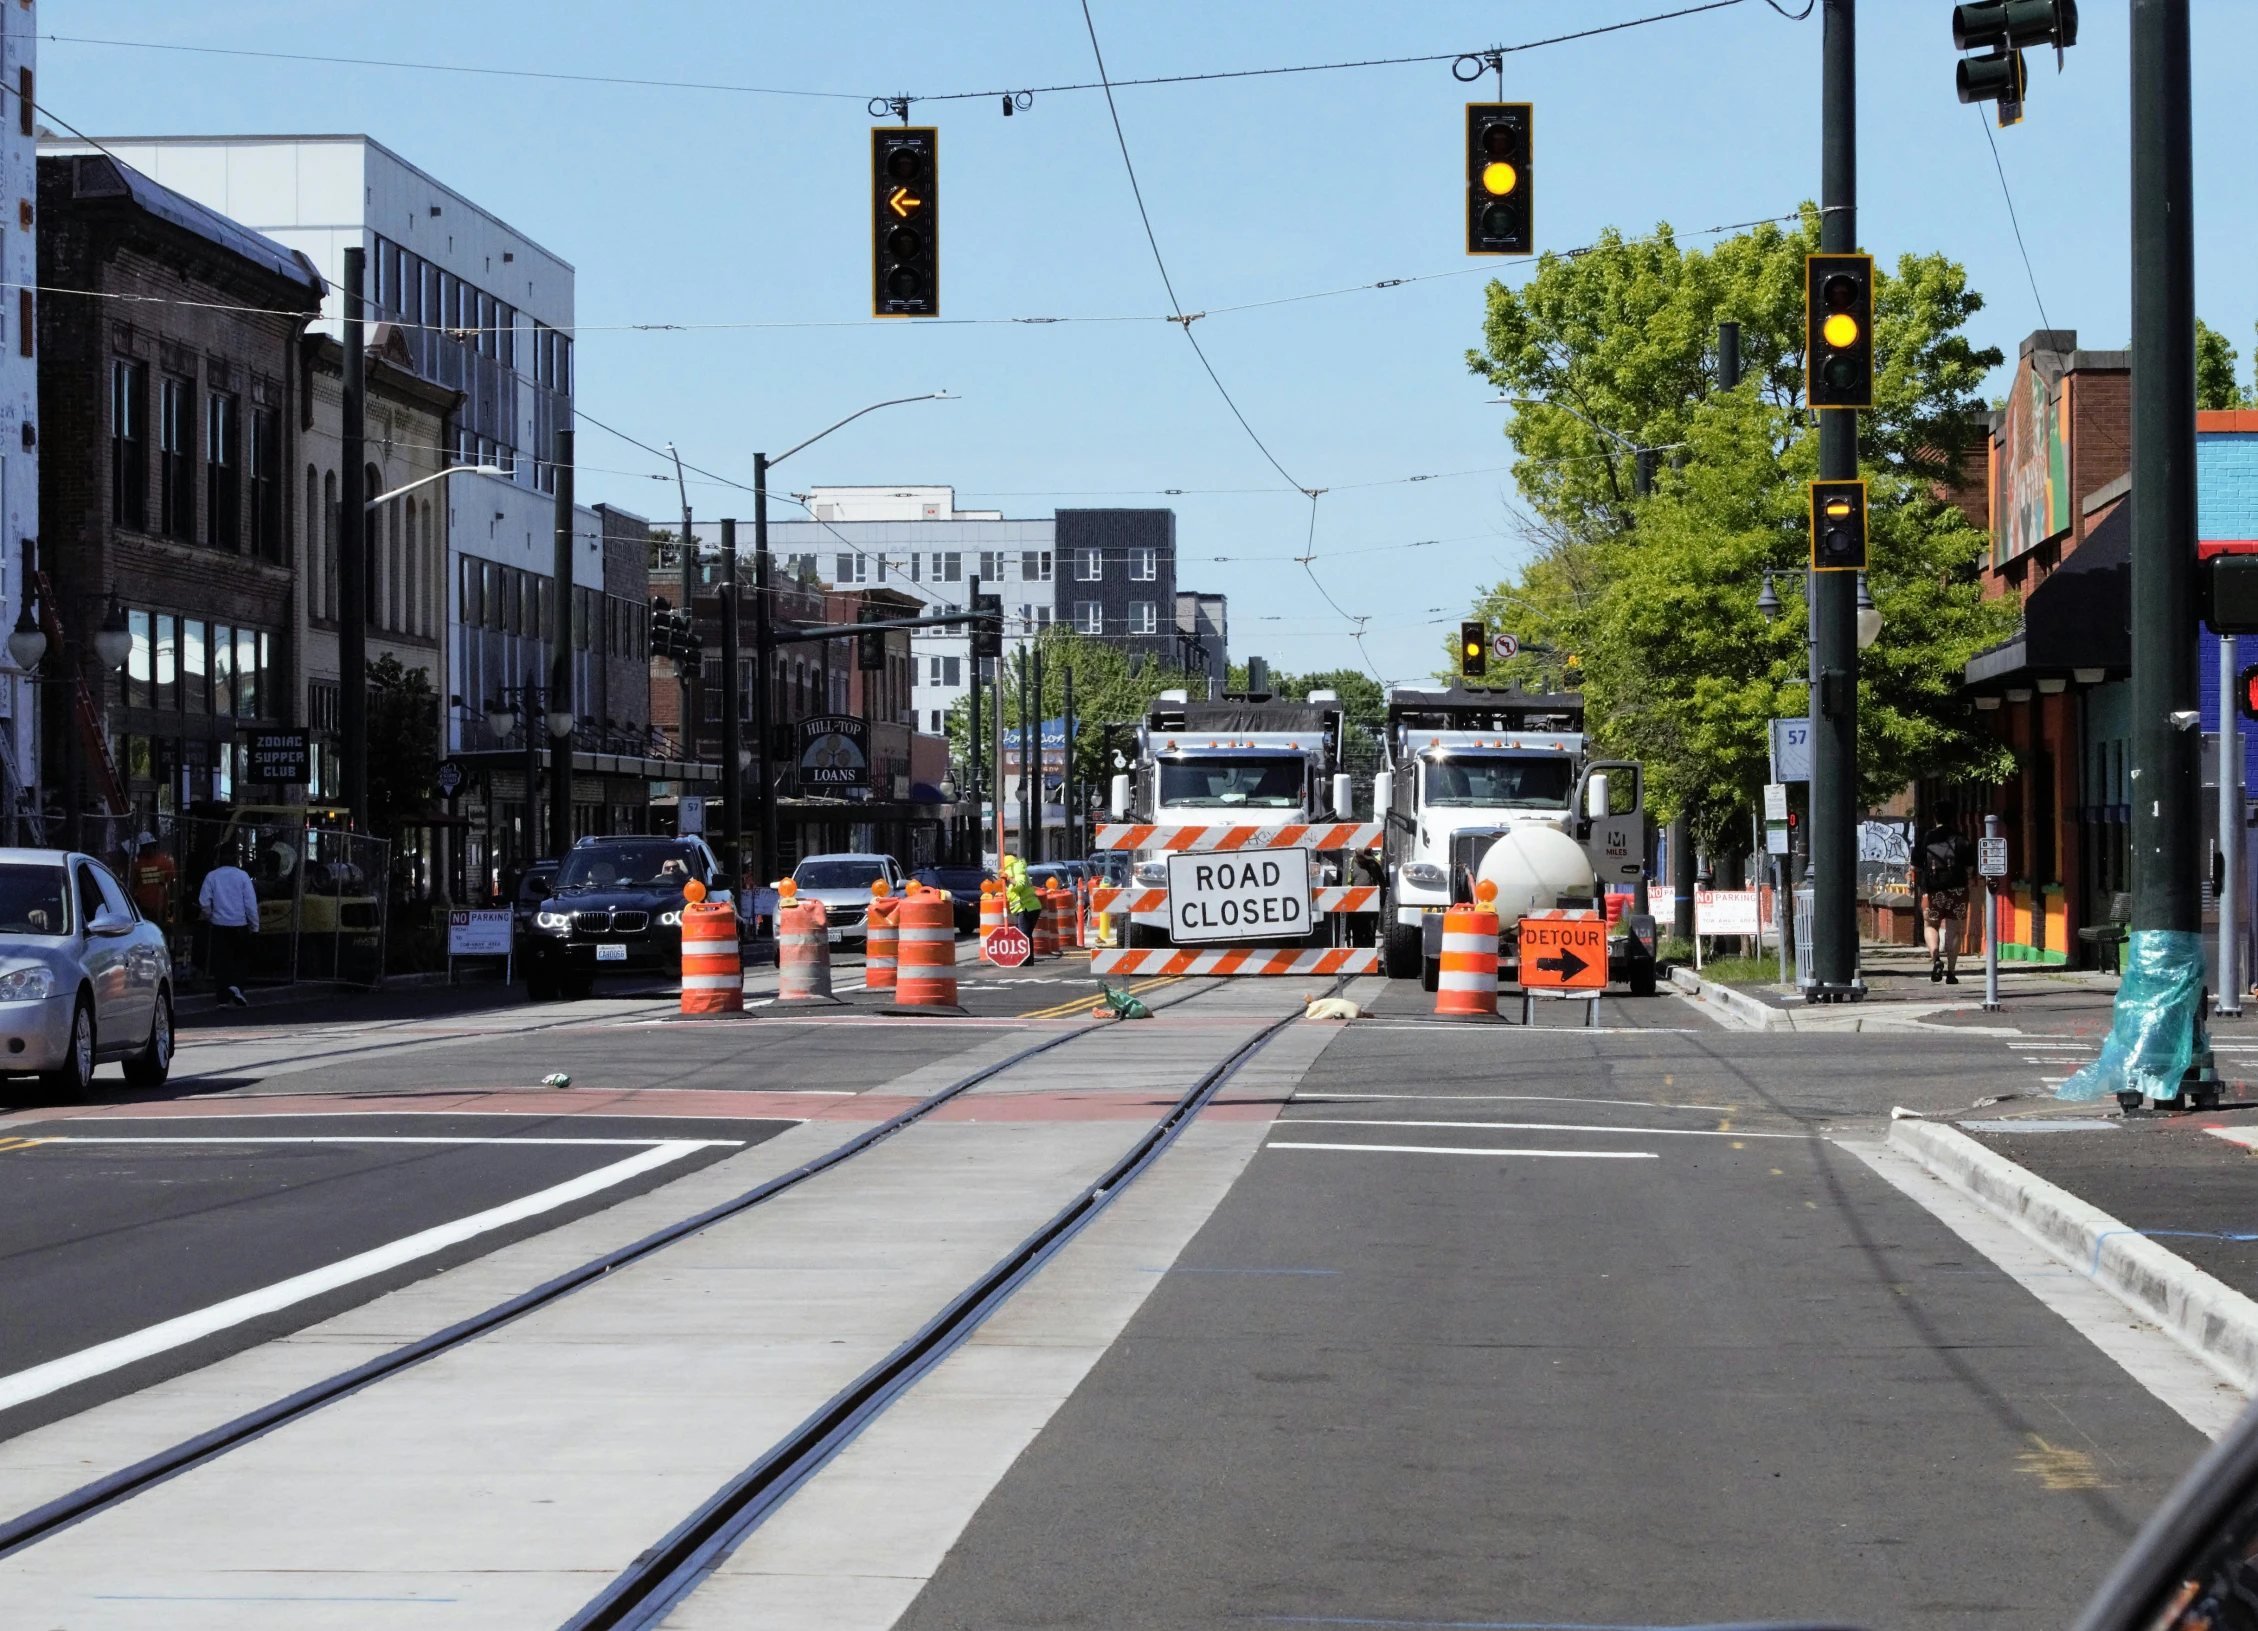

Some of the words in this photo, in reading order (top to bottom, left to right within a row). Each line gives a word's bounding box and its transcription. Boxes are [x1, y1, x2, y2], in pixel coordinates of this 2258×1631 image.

[256, 735, 303, 747] ZODIAC
[1788, 729, 1807, 745] 57
[254, 751, 305, 763] SUPPER
[263, 766, 296, 777] CLUB
[814, 769, 856, 781] LOANS
[687, 802, 699, 811] 57
[1606, 848, 1628, 856] MILES
[1196, 861, 1280, 892] ROAD
[1649, 888, 1662, 898] NO
[1696, 893, 1713, 904] NO
[1715, 893, 1756, 902] PARKING
[452, 912, 467, 924] NO
[471, 912, 510, 922] PARKING
[1181, 896, 1300, 929] CLOSED
[1525, 929, 1600, 946] DETOUR
[988, 939, 1027, 955] STOP
